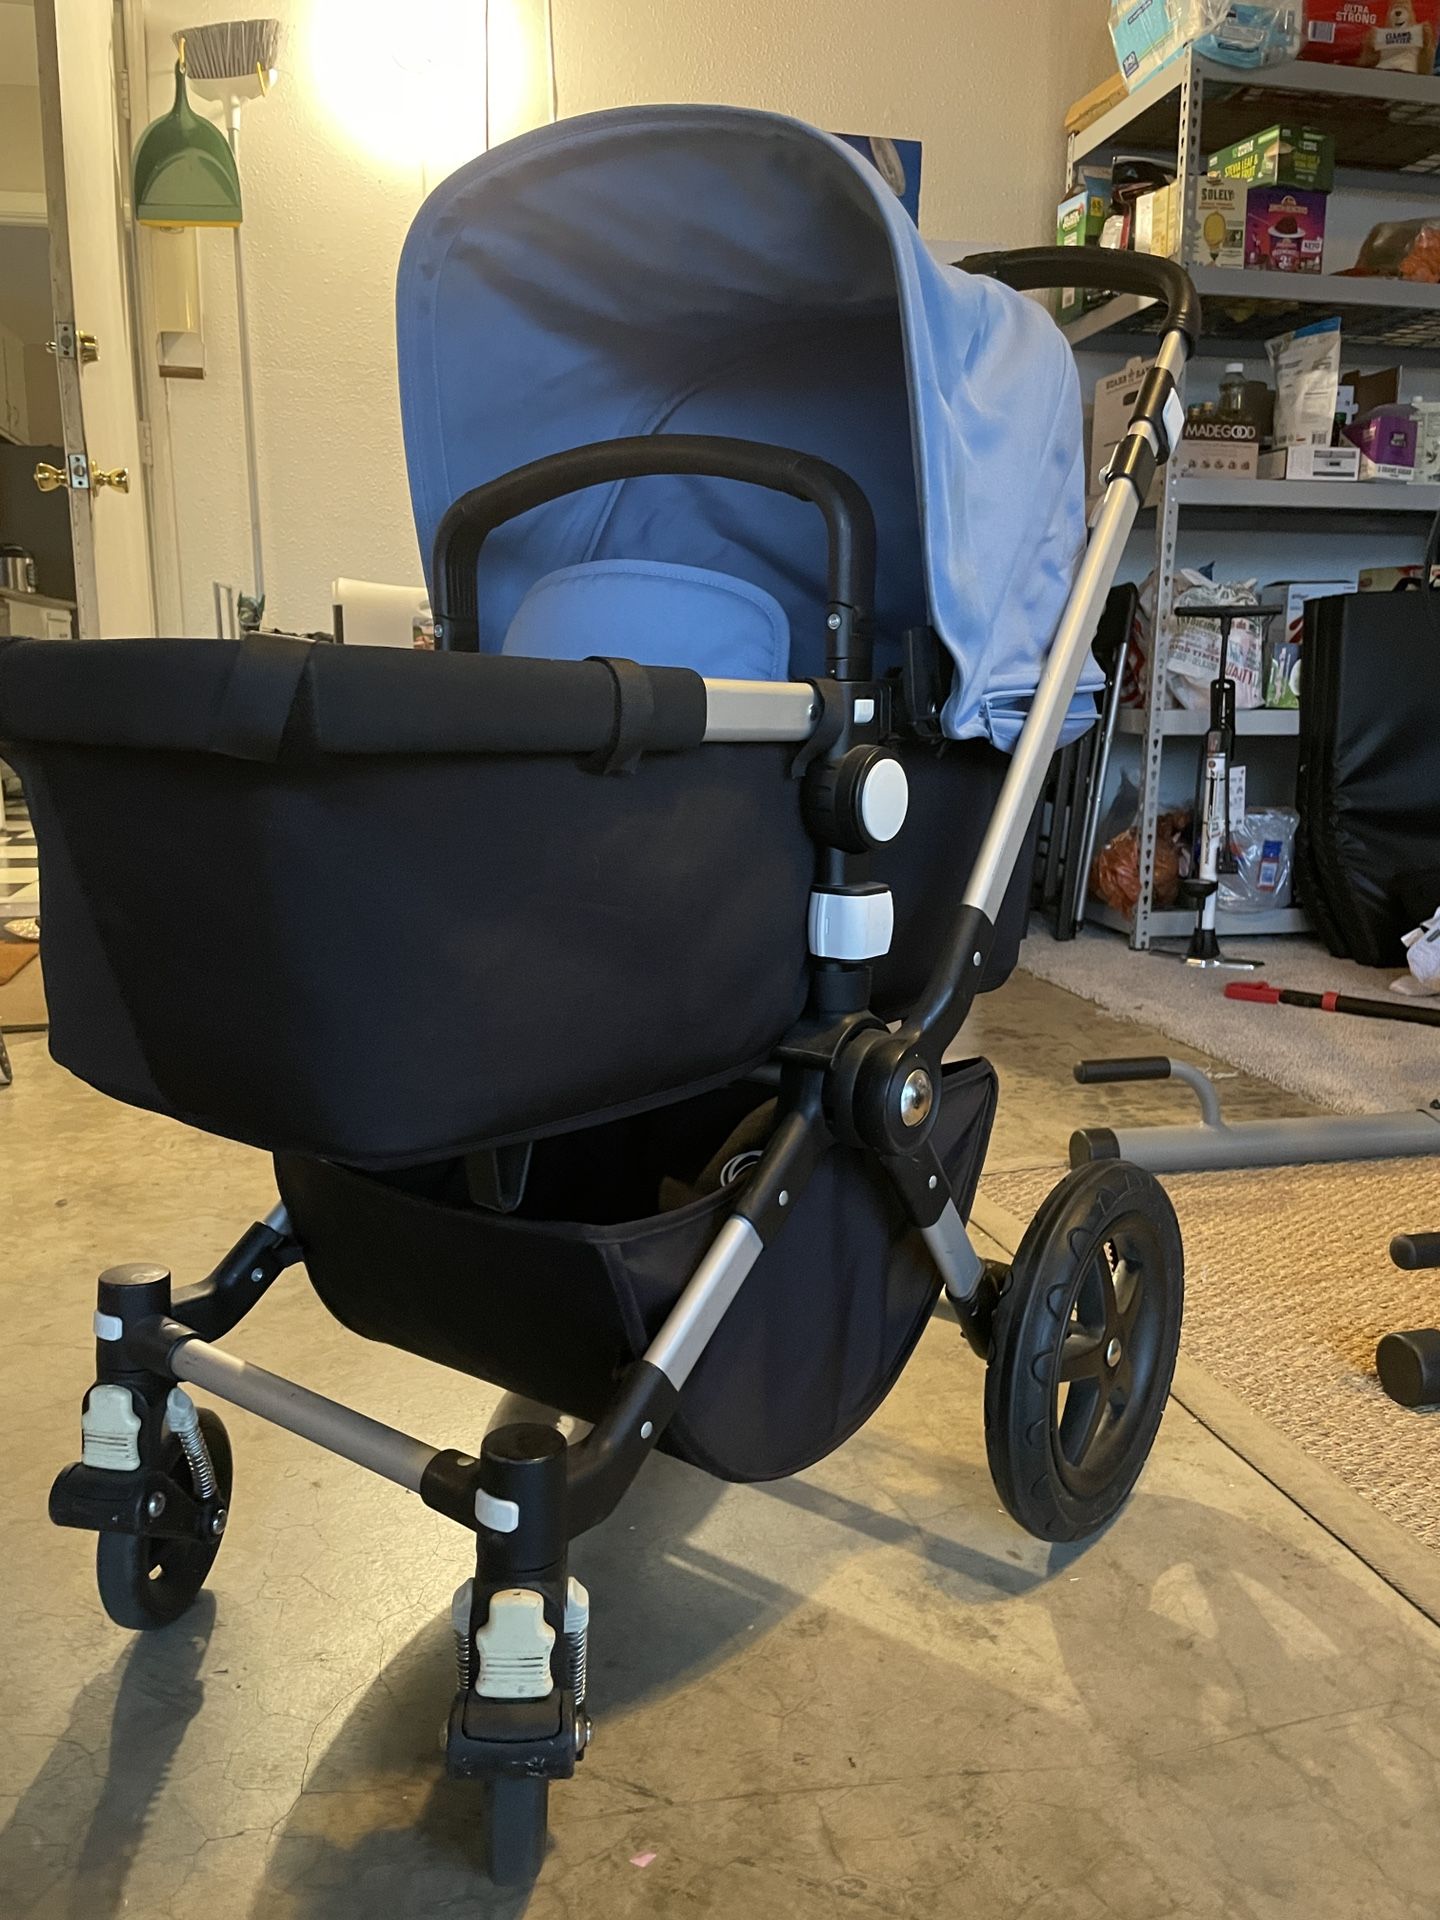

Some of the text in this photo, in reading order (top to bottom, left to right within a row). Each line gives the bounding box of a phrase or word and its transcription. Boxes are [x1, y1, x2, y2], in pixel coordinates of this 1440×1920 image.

[1343, 3, 1369, 13] ULTRA
[1335, 11, 1377, 25] STRONG
[1201, 187, 1234, 201] SOLELY
[1185, 423, 1256, 439] MADEGOOD
